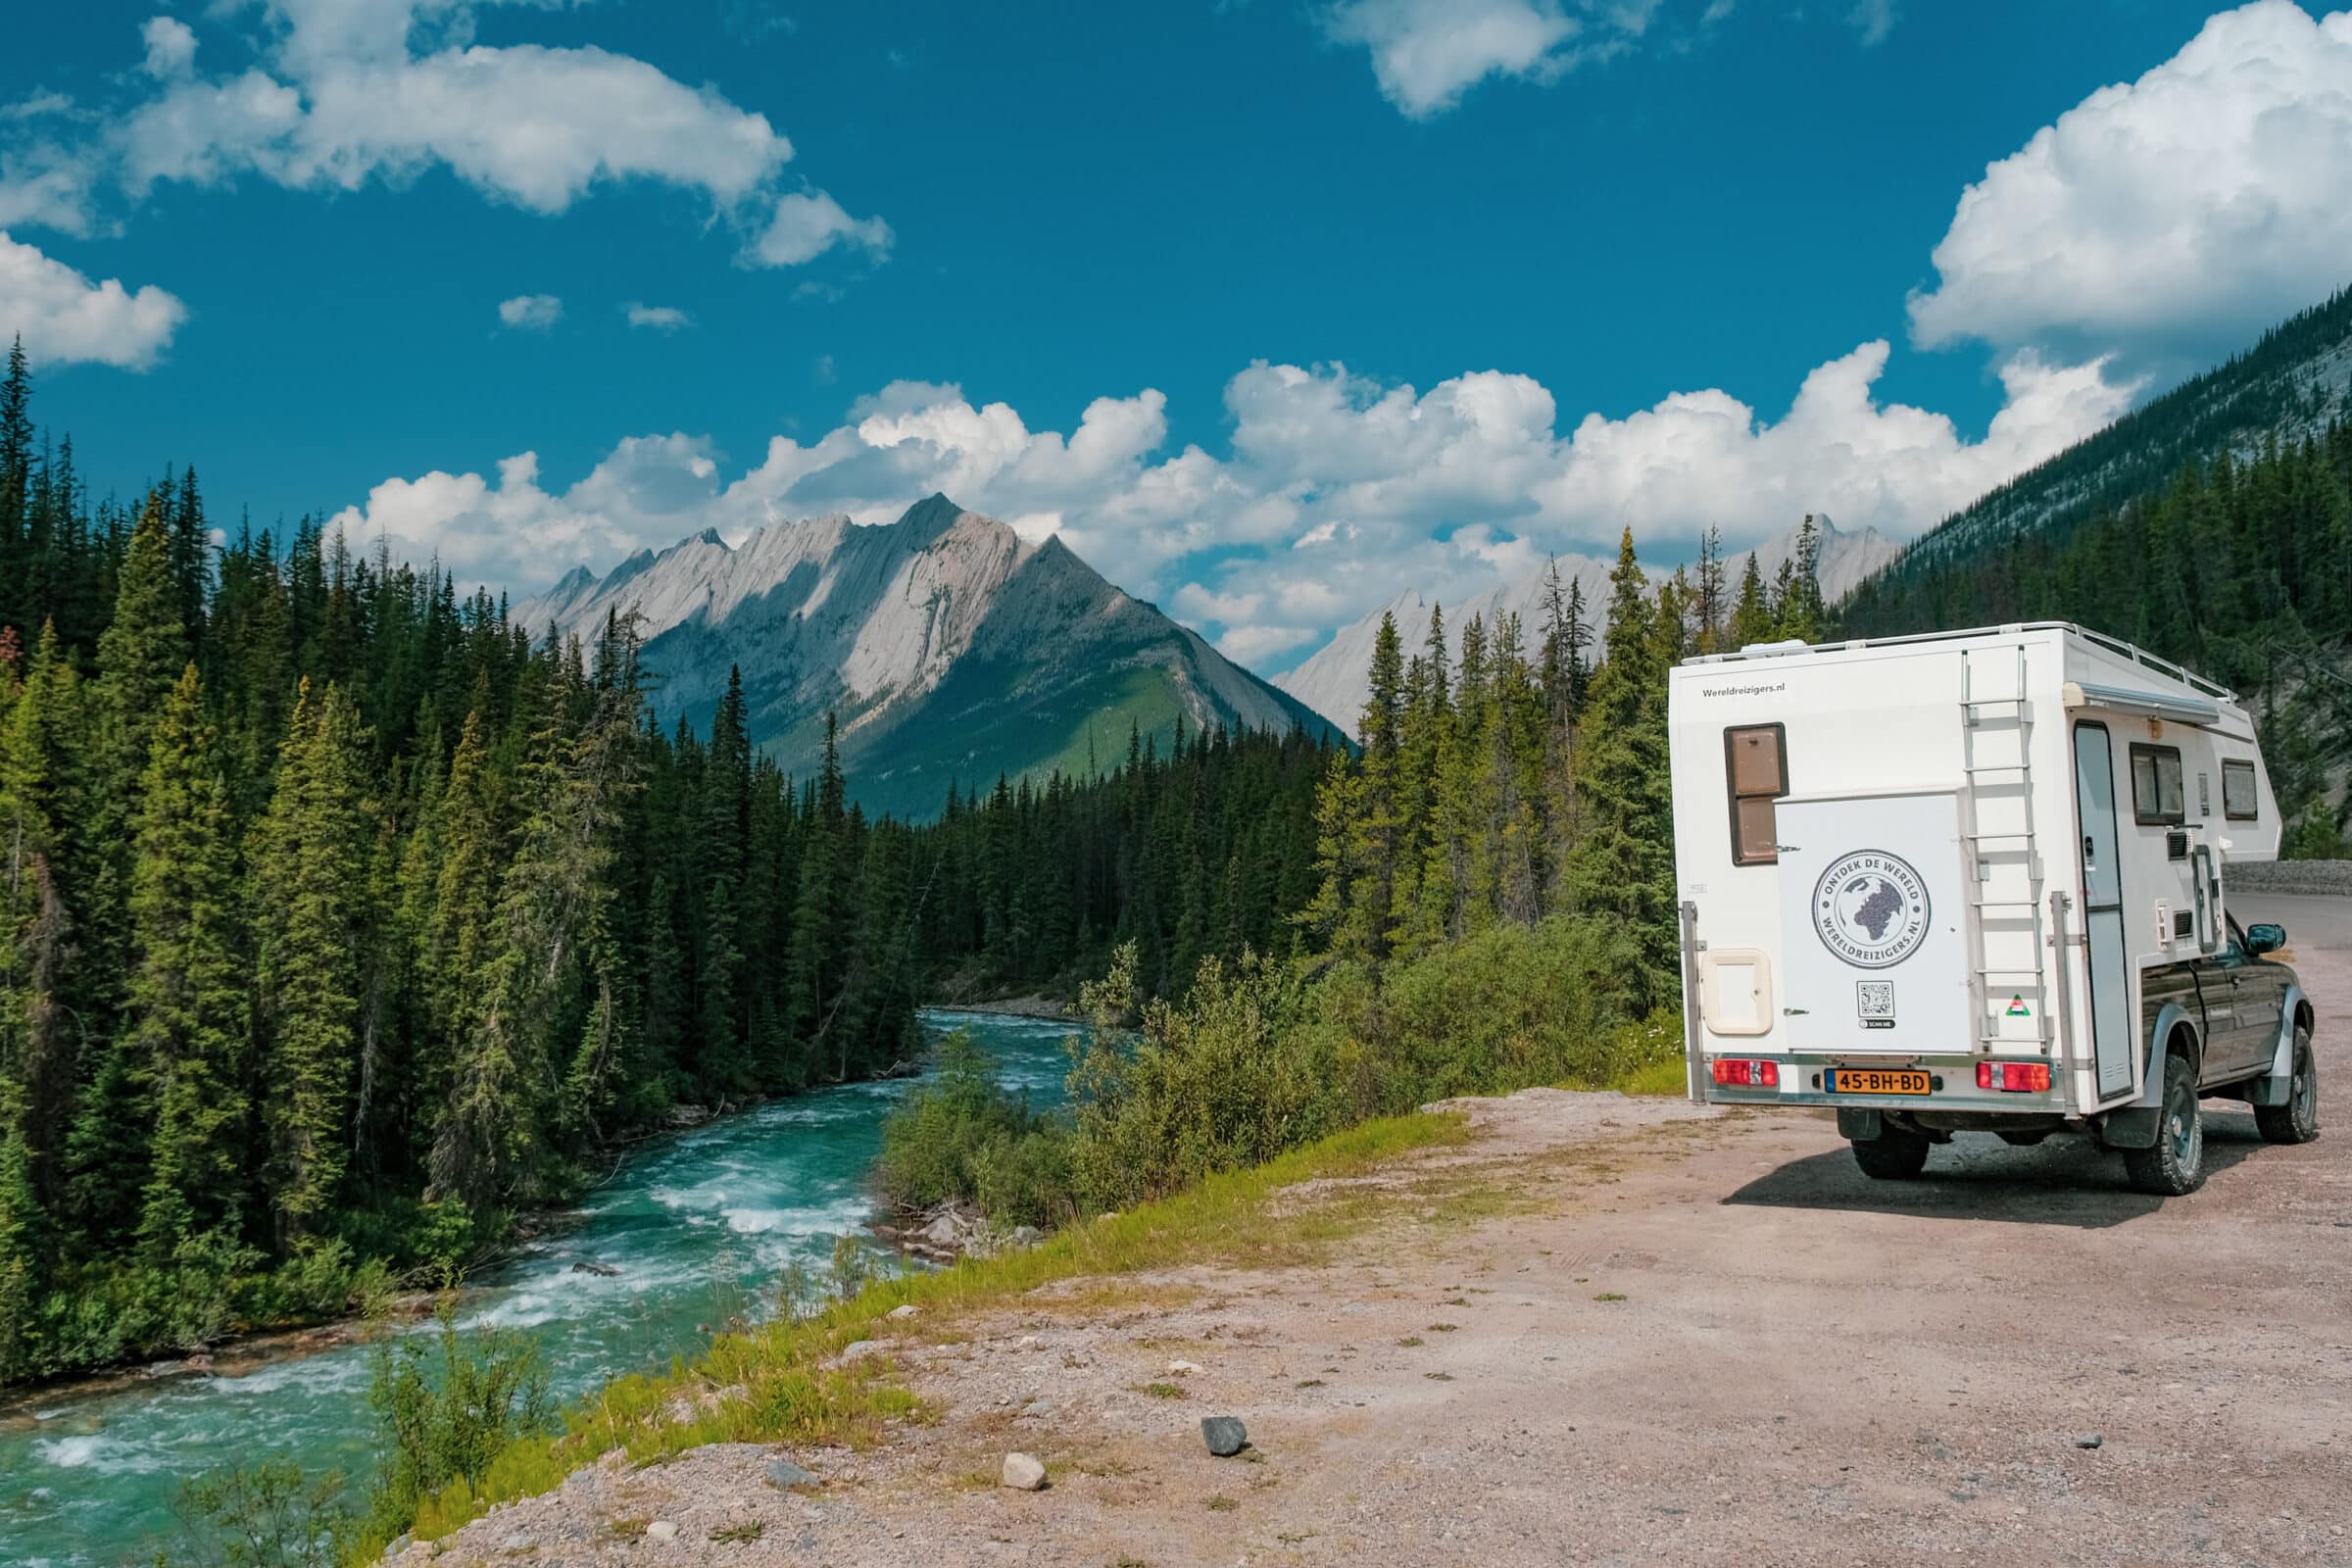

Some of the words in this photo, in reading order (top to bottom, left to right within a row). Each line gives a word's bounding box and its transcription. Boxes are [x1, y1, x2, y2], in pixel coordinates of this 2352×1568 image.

[1702, 682, 1786, 698] Wereldreizigers.nl
[1824, 859, 1862, 895] ONTDEK
[1865, 858, 1880, 868] DE
[1884, 861, 1919, 900] WERELD
[1823, 916, 1921, 960] WERELDREIZIGERS.NL
[1839, 1073, 1925, 1091] 45-BH-BD
